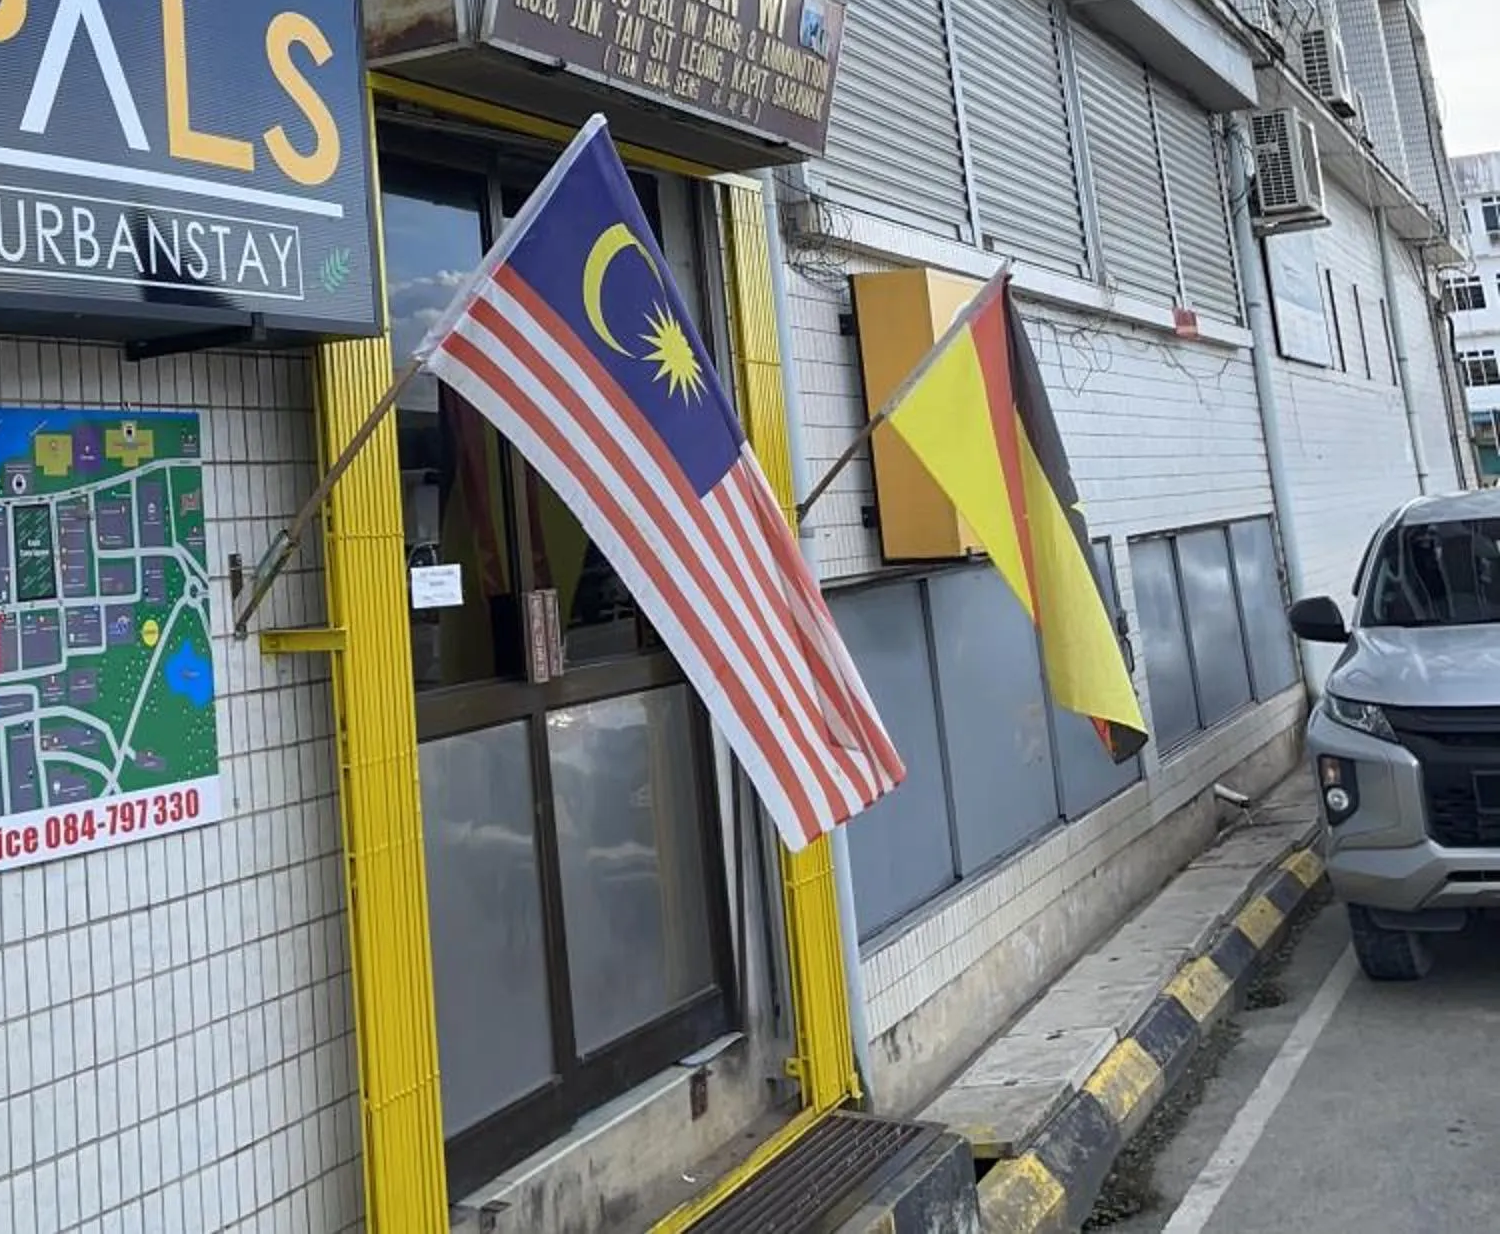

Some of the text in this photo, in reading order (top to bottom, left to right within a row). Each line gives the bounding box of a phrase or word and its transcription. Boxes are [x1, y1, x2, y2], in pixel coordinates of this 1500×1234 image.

[612, 9, 644, 53] TAN
[649, 24, 676, 64] SIT
[772, 75, 824, 122] SARAWAK
[680, 0, 698, 35] IN
[703, 8, 742, 54] ARMS
[746, 29, 758, 60] &
